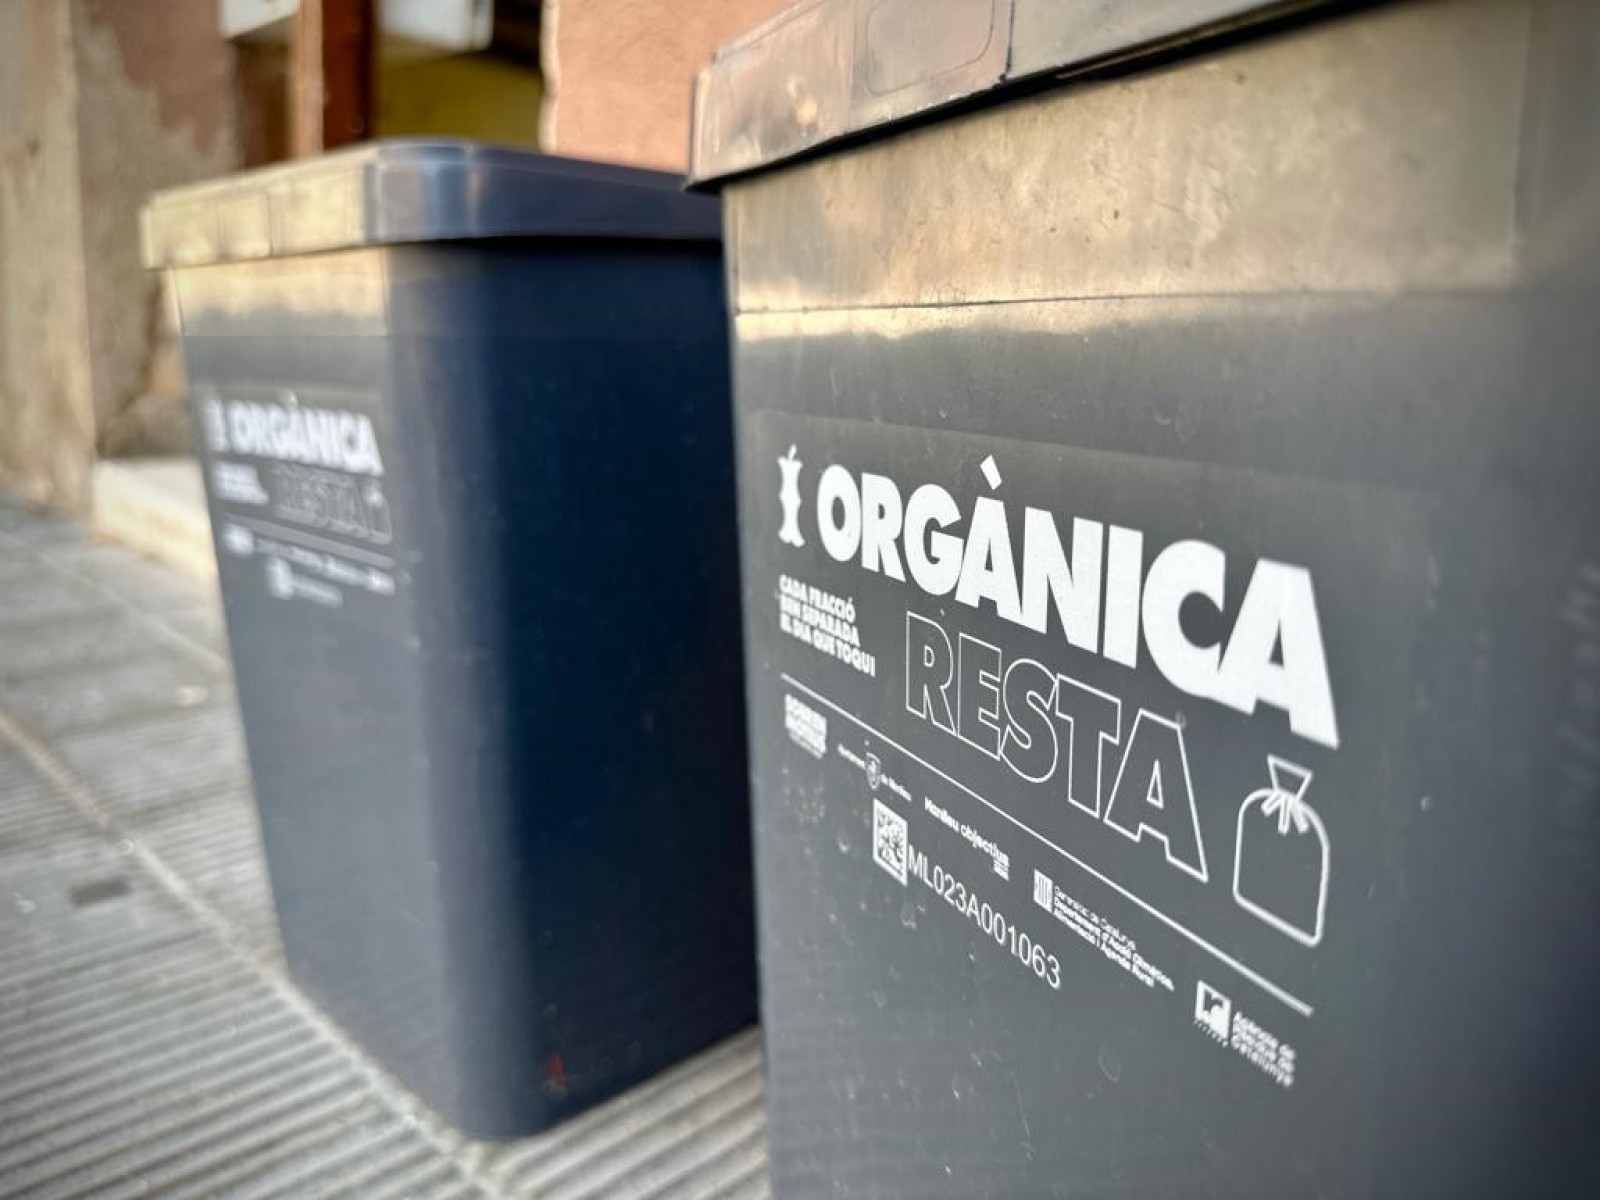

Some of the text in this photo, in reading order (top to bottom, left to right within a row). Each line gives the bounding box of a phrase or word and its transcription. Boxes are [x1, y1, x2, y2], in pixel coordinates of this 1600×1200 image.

[808, 586, 856, 624] FRACCIÓ
[816, 454, 1340, 750] ORGÀNICA
[836, 638, 876, 678] TOQUI
[906, 610, 1209, 882] RESTA
[908, 843, 1061, 989] ML023A001063
